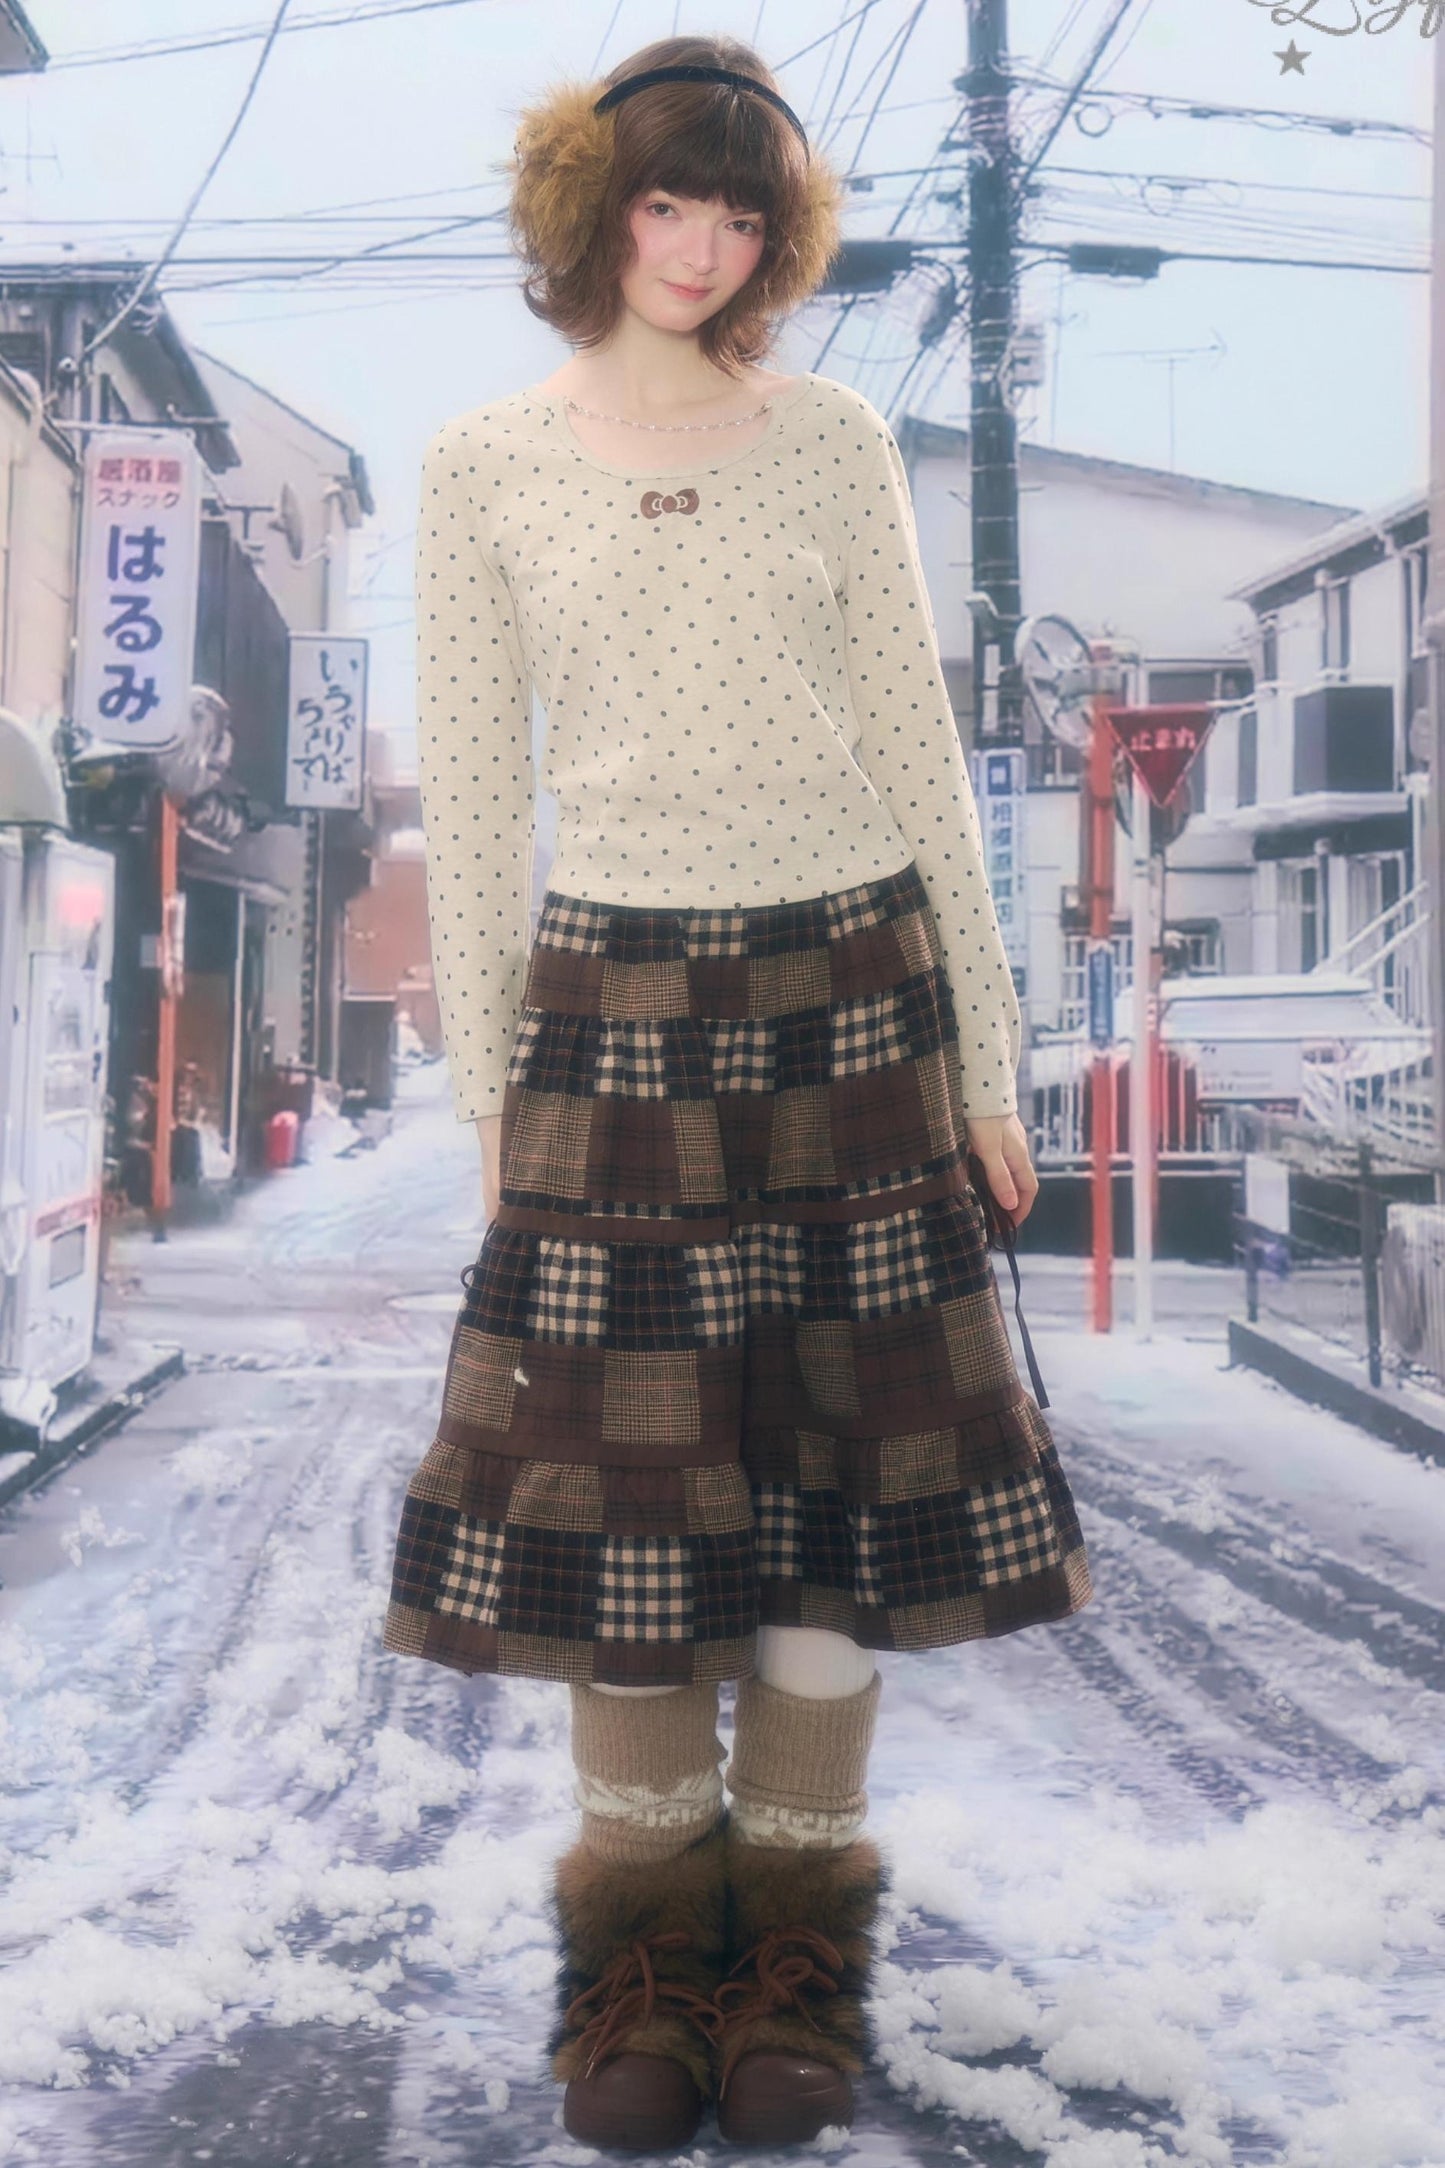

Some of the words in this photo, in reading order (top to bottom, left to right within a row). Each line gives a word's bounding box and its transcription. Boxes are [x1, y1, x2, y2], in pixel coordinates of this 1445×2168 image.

[97, 488, 180, 509] スナック
[98, 524, 166, 724] はるみ
